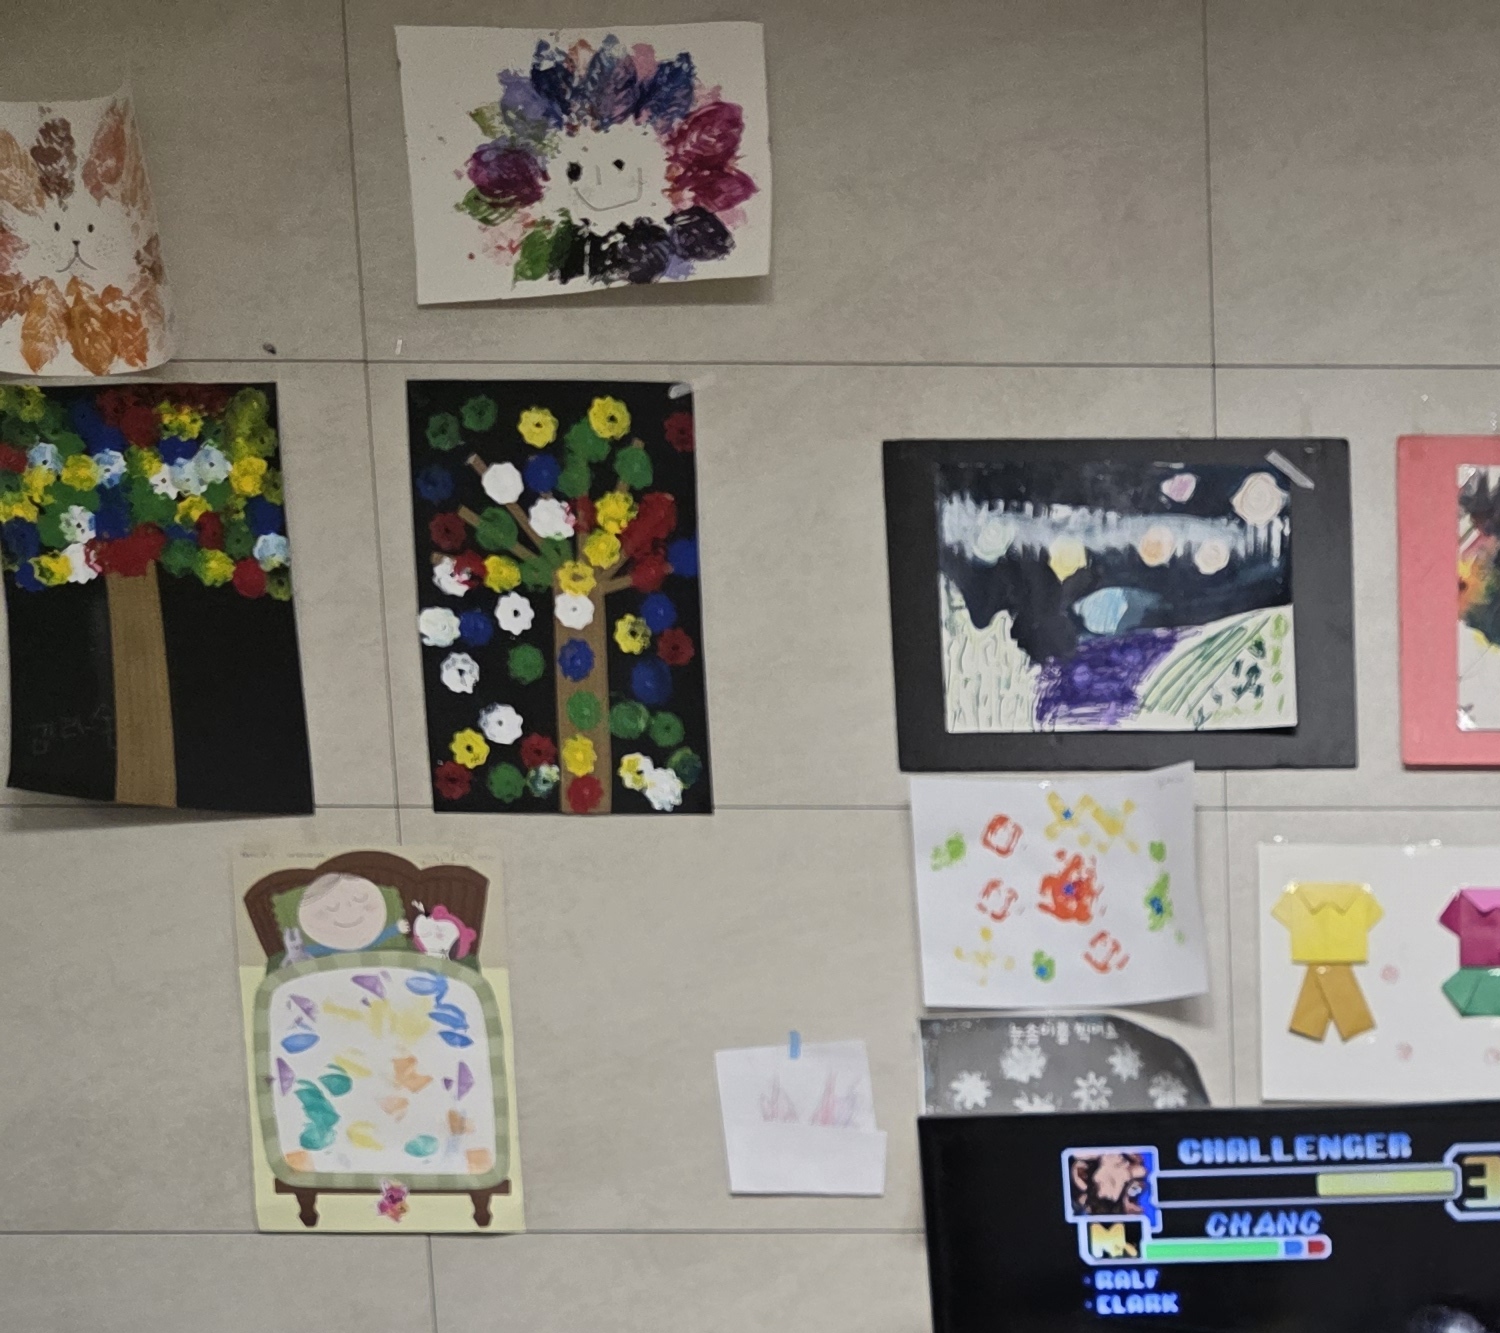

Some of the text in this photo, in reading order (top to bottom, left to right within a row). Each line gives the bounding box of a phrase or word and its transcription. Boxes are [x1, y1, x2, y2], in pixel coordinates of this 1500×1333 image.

[1177, 1132, 1413, 1165] CHALLENGER
[1205, 1209, 1323, 1238] CHANG
[1095, 1268, 1158, 1290] RALF
[1095, 1292, 1180, 1315] CLARK
